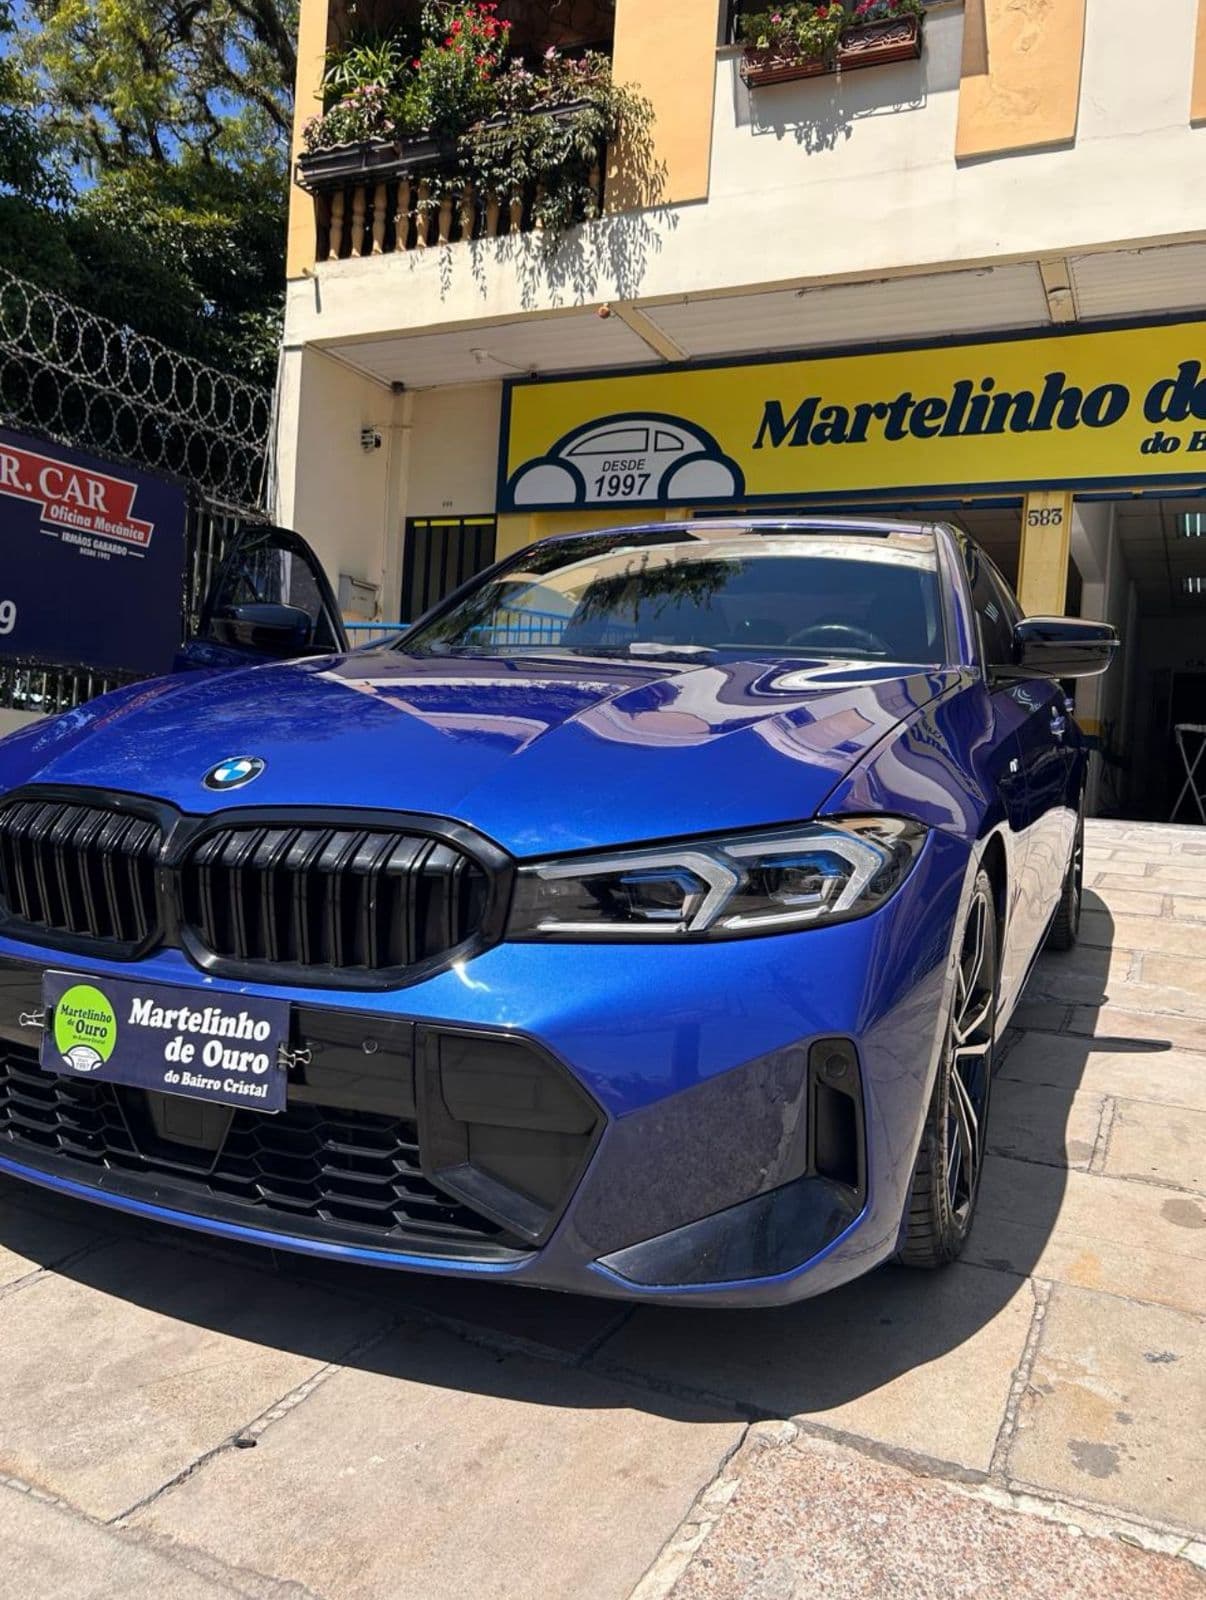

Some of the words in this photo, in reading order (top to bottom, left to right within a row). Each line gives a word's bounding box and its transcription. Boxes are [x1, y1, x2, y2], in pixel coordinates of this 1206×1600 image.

[752, 372, 1130, 450] Martelinho
[1140, 431, 1181, 454] do
[602, 459, 645, 472] DESDE
[39, 467, 109, 513] CAR
[594, 474, 651, 497] 1997
[50, 505, 90, 527] Oficina
[93, 515, 145, 541] Mecânica
[1028, 510, 1063, 527] 583
[60, 1004, 112, 1023] Martelinho
[128, 998, 271, 1041] Martelinho
[75, 1019, 108, 1038] Ouro
[164, 1036, 195, 1064] de
[202, 1040, 269, 1075] Ouro
[164, 1070, 180, 1083] do
[181, 1072, 222, 1090] Bairro
[223, 1079, 268, 1098] Cristal
